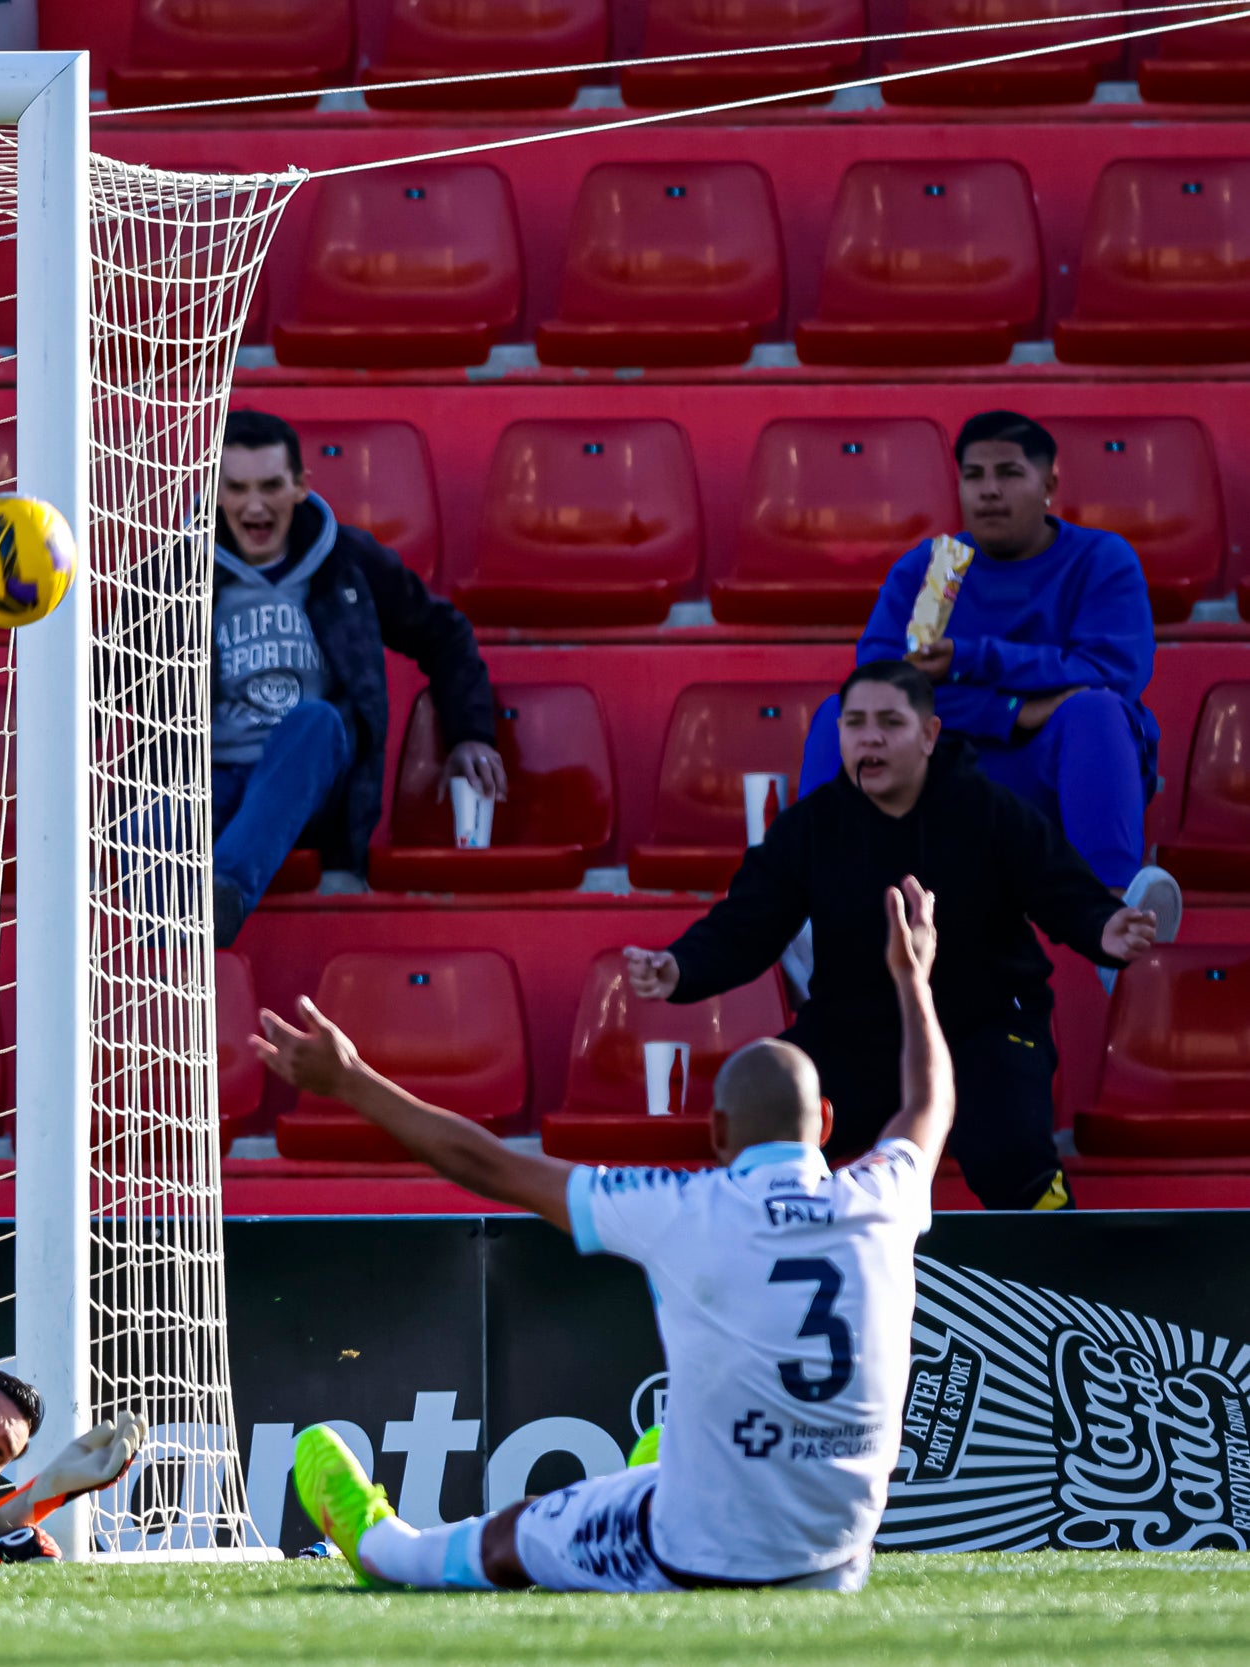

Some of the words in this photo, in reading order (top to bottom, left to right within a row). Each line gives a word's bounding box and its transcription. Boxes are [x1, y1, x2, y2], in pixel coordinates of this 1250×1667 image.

[768, 1257, 855, 1402] 3
[903, 1370, 943, 1441] AFTER
[943, 1352, 972, 1406] SPORT
[1112, 1347, 1164, 1402] de
[923, 1419, 956, 1472] PARTY
[940, 1407, 960, 1420] &
[1055, 1330, 1164, 1549] Mano
[1221, 1395, 1248, 1435] DRINK
[90, 1389, 630, 1558] anto
[1132, 1367, 1248, 1551] Santo
[1222, 1430, 1250, 1530] RECOVERY
